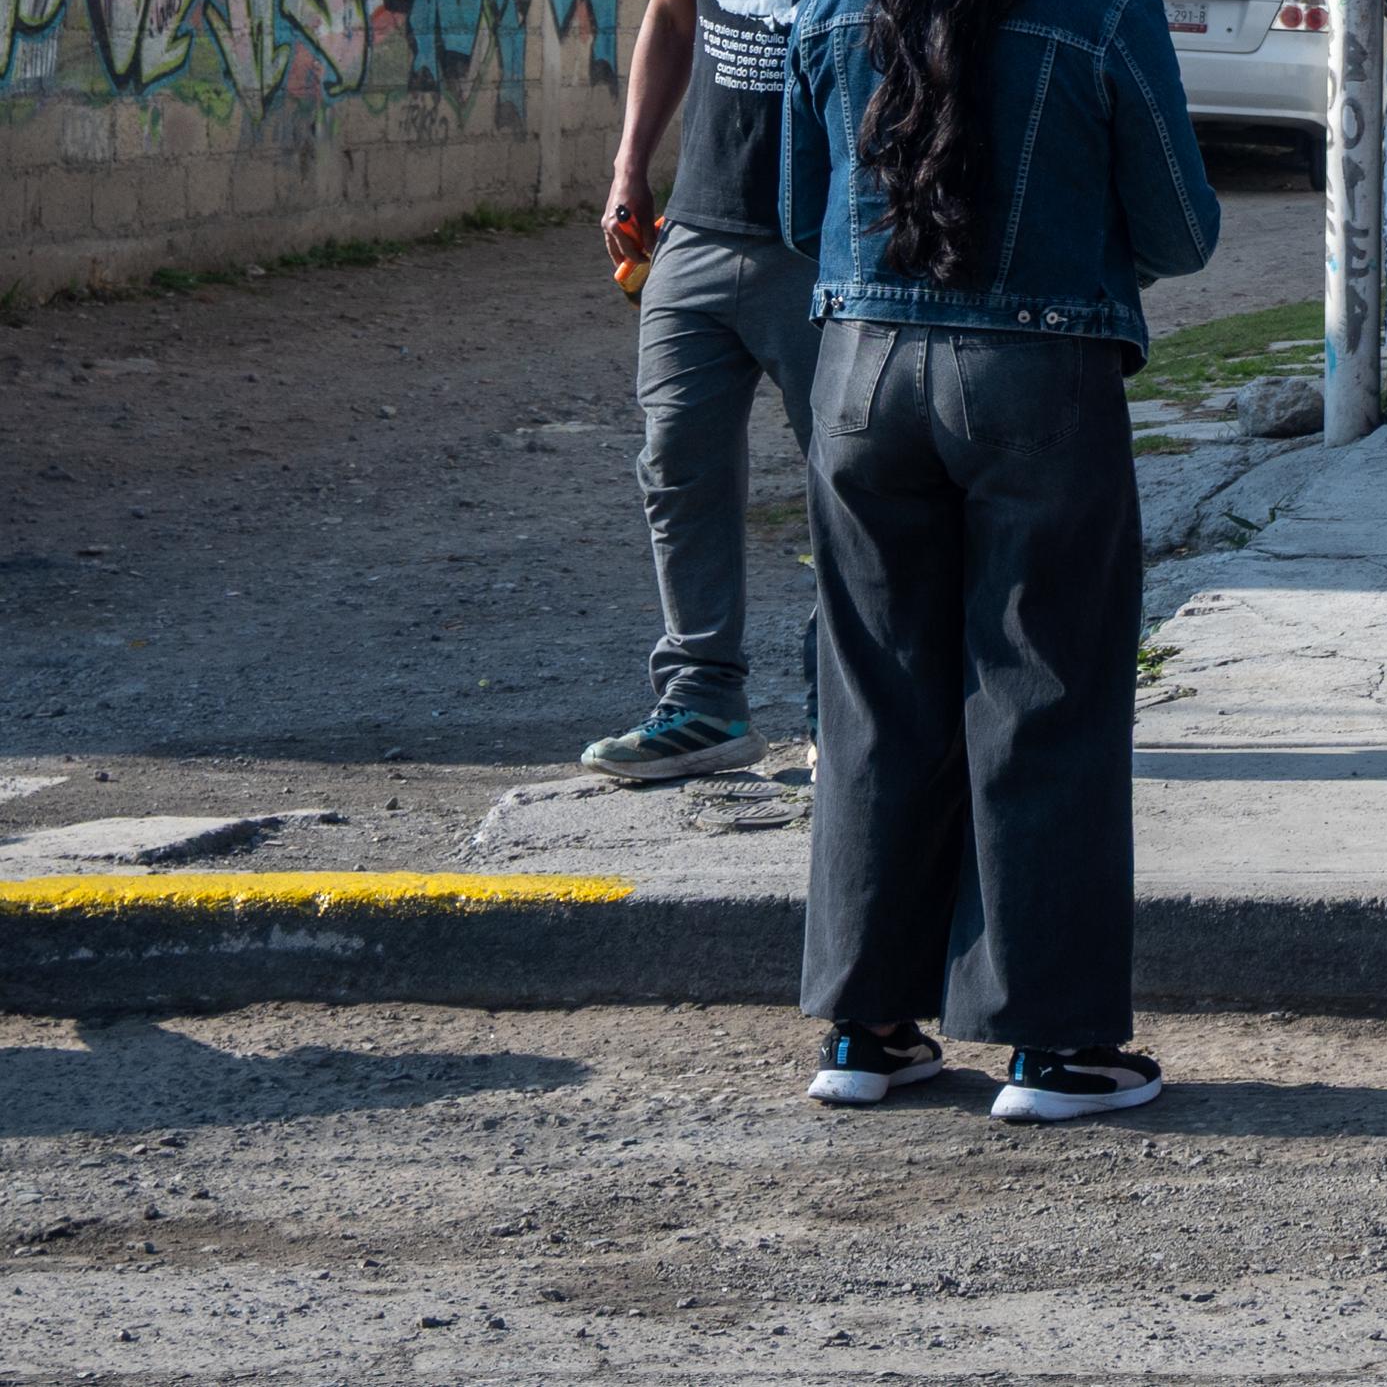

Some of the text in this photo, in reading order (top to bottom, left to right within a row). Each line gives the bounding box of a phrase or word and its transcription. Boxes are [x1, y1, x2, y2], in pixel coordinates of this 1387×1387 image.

[715, 24, 739, 38] quiera
[741, 30, 754, 41] ser
[755, 30, 784, 45] águila
[722, 39, 747, 52] quiera
[749, 44, 762, 54] ser
[737, 55, 757, 66] pero
[758, 58, 778, 69] que
[717, 63, 747, 77] cuando
[749, 68, 758, 78] lo
[715, 72, 748, 90] Emiliano
